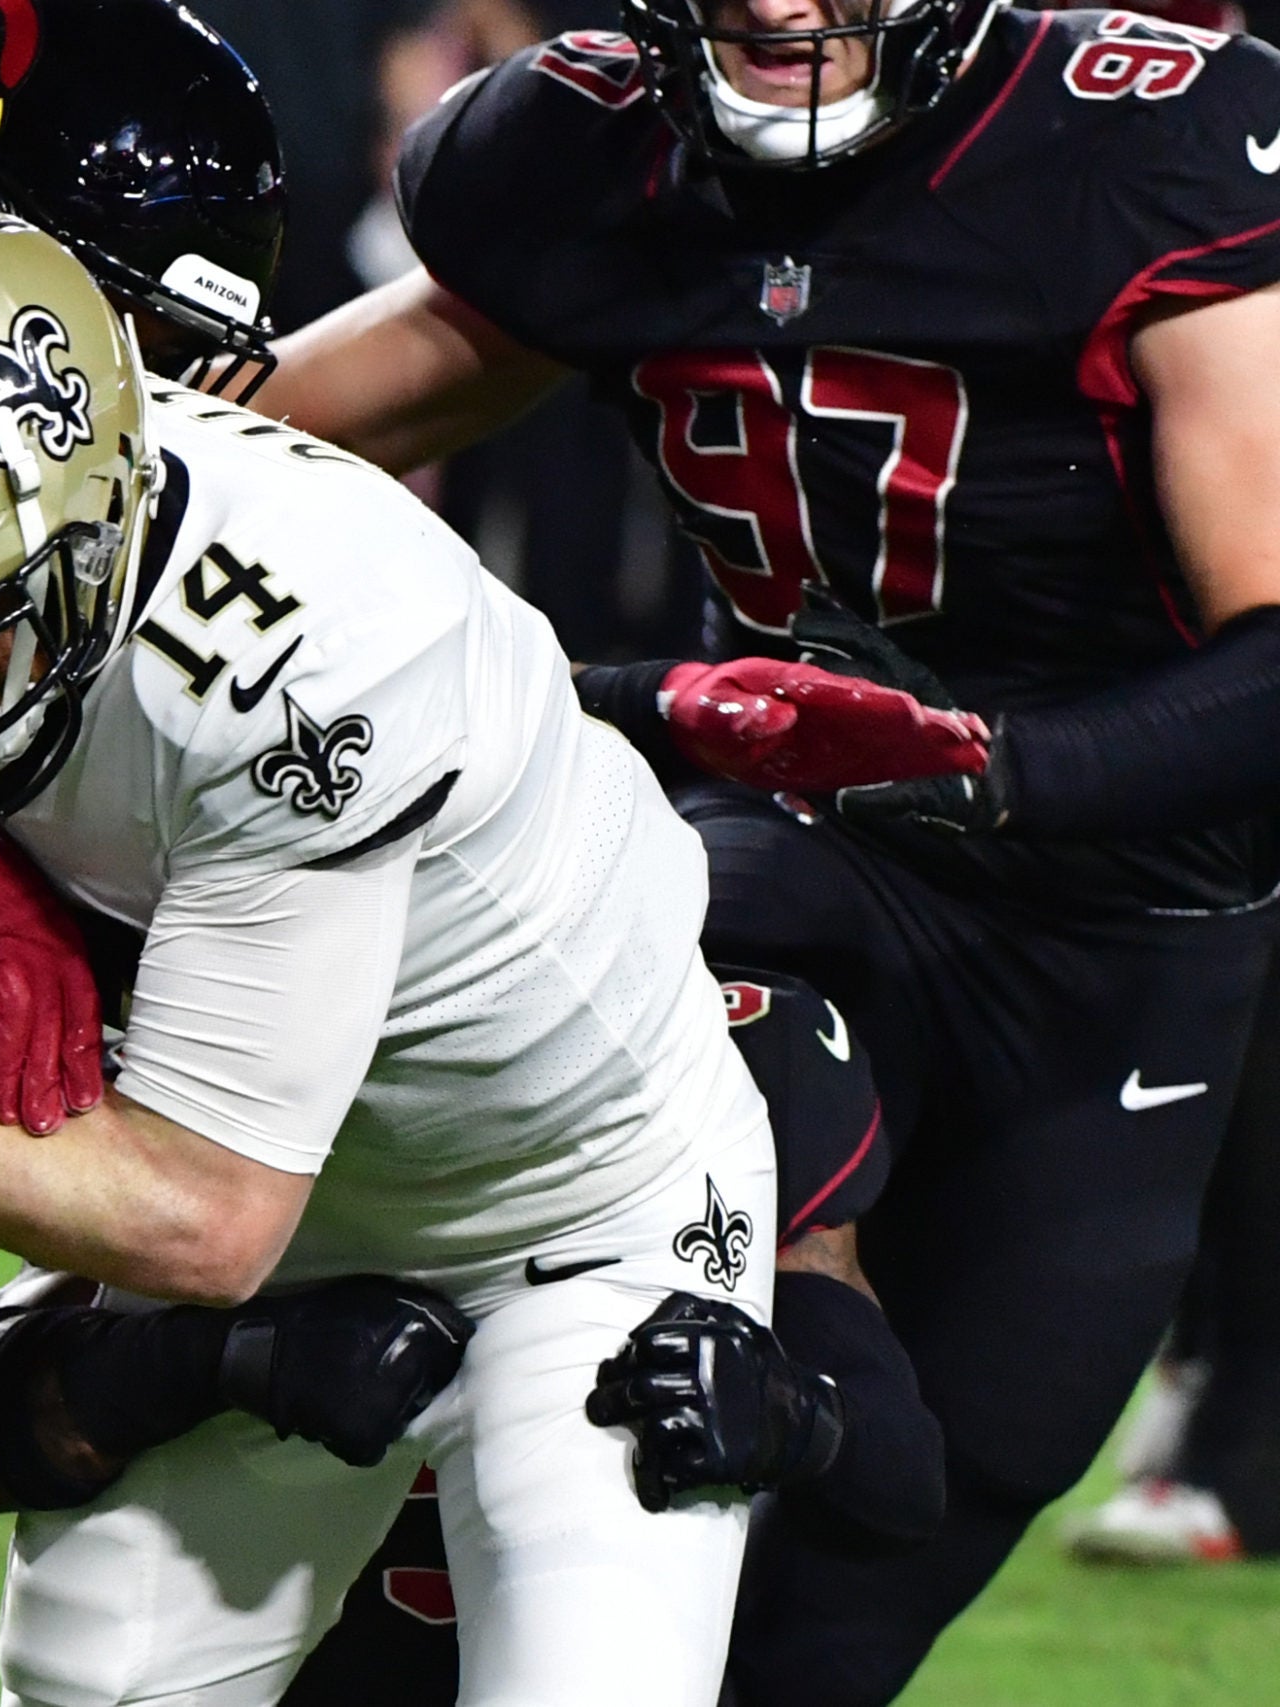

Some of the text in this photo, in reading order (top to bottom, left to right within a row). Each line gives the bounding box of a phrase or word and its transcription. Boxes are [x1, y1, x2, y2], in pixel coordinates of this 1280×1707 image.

[194, 275, 248, 308] ARIZONA
[631, 345, 969, 637] 97
[133, 541, 307, 706] 14
